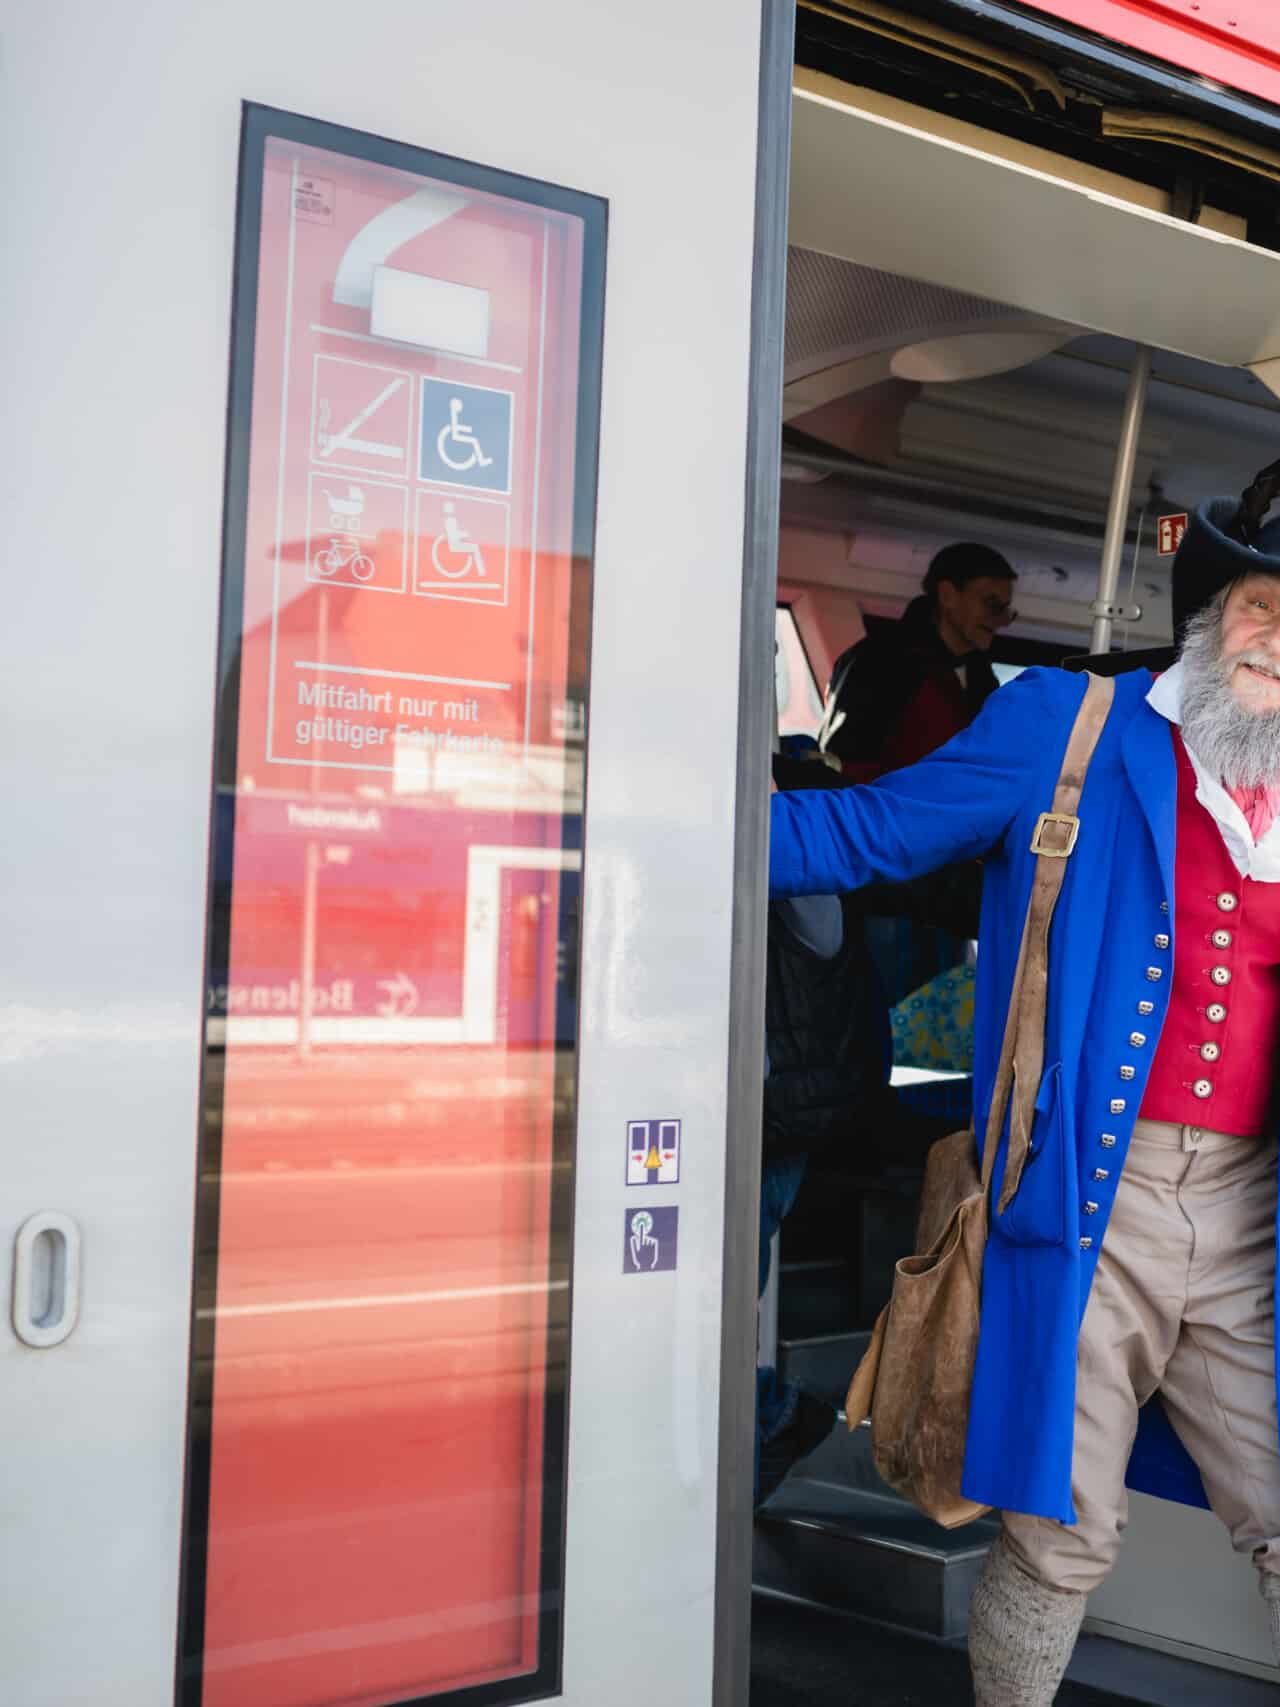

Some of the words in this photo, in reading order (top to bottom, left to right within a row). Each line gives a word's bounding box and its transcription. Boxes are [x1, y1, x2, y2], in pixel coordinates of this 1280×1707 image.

[297, 680, 393, 714] Mitfahrt
[398, 696, 438, 718] nur
[443, 698, 479, 721] mit
[296, 716, 389, 750] gültiger
